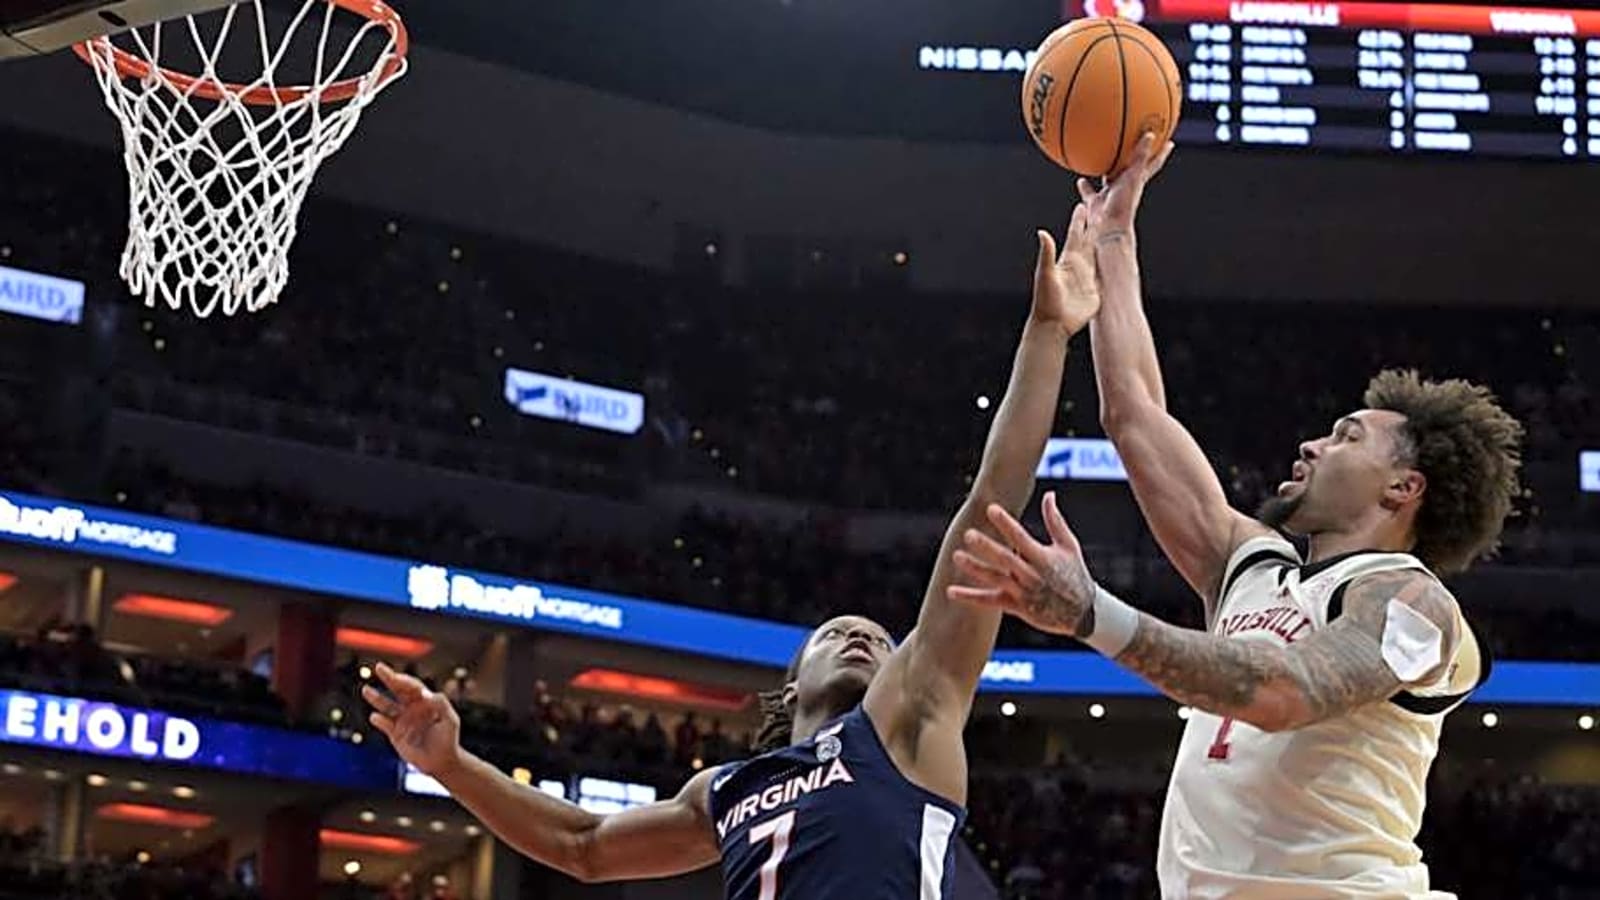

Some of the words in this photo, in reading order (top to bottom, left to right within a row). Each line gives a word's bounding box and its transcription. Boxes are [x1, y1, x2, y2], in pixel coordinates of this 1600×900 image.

[1031, 73, 1054, 138] NCAA
[451, 574, 541, 619] Ruoff
[716, 757, 855, 840] VIRGINIA
[749, 810, 796, 900] 7
